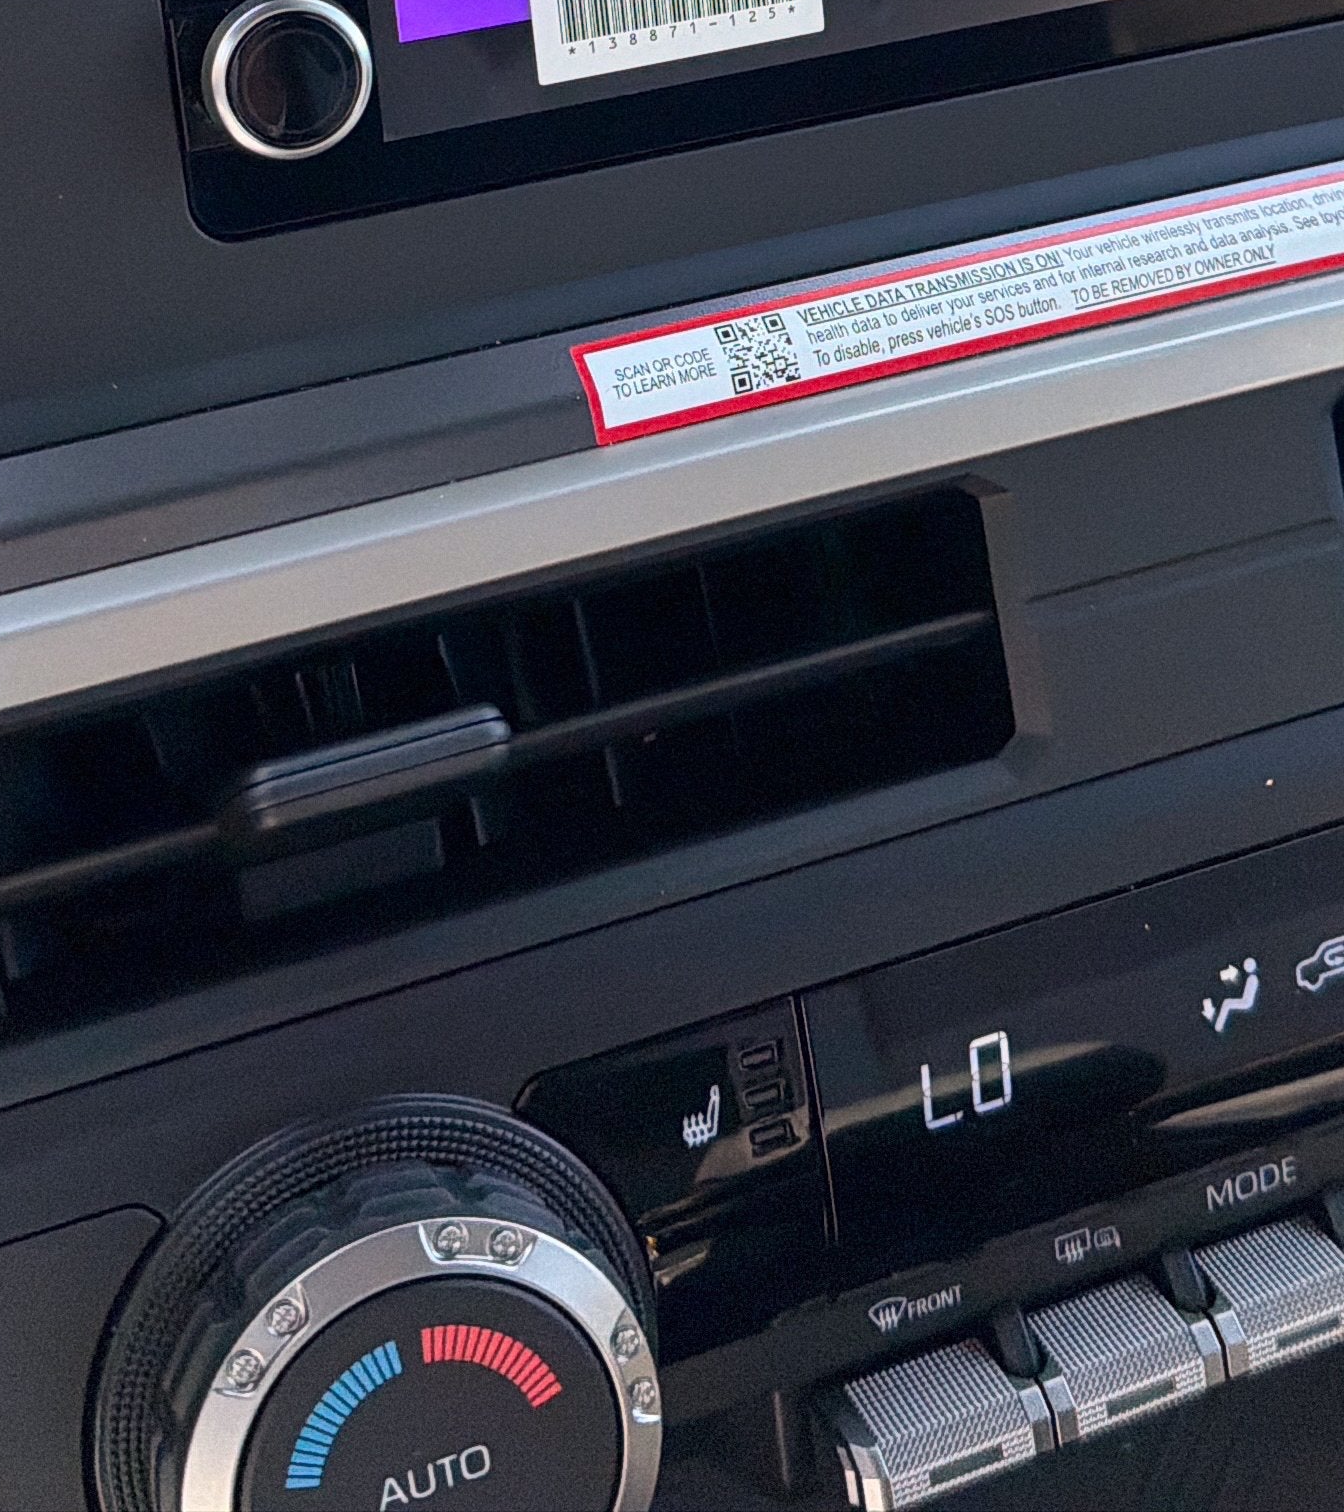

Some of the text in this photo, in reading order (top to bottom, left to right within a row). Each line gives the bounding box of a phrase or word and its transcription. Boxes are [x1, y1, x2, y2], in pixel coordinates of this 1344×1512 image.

[796, 296, 864, 325] VEHICLE
[864, 287, 907, 312] DATA
[906, 260, 1017, 300] TRANSMISSION
[1019, 257, 1034, 274] IS
[1036, 250, 1064, 270] ON!
[1062, 244, 1094, 263] Your
[1096, 234, 1141, 254] vehicle
[1141, 220, 1202, 245] wirelessly
[1203, 209, 1260, 230] transmits
[1259, 196, 1312, 218] location,
[806, 320, 850, 345] health
[851, 313, 882, 335] data
[883, 310, 898, 327] to
[901, 300, 944, 323] deliver
[946, 293, 976, 316] your
[980, 281, 1032, 305] services
[1033, 271, 1058, 290] and
[1059, 266, 1078, 285] for
[1079, 256, 1125, 278] internal
[1127, 245, 1183, 268] research
[1183, 238, 1209, 257] and
[1209, 231, 1239, 250] data
[1240, 221, 1293, 243] analysis.
[1291, 213, 1320, 230] See
[813, 243, 1276, 367] To disable, press vehicle's SOS button. TO BE REMOVED BY OWNER ONLY
[612, 362, 718, 400] TO LEARN MORE
[614, 347, 713, 382] SCAN QR CODE
[1205, 1156, 1298, 1213] MODE
[907, 1284, 961, 1320] FRONT
[380, 1444, 491, 1511] AUTO
